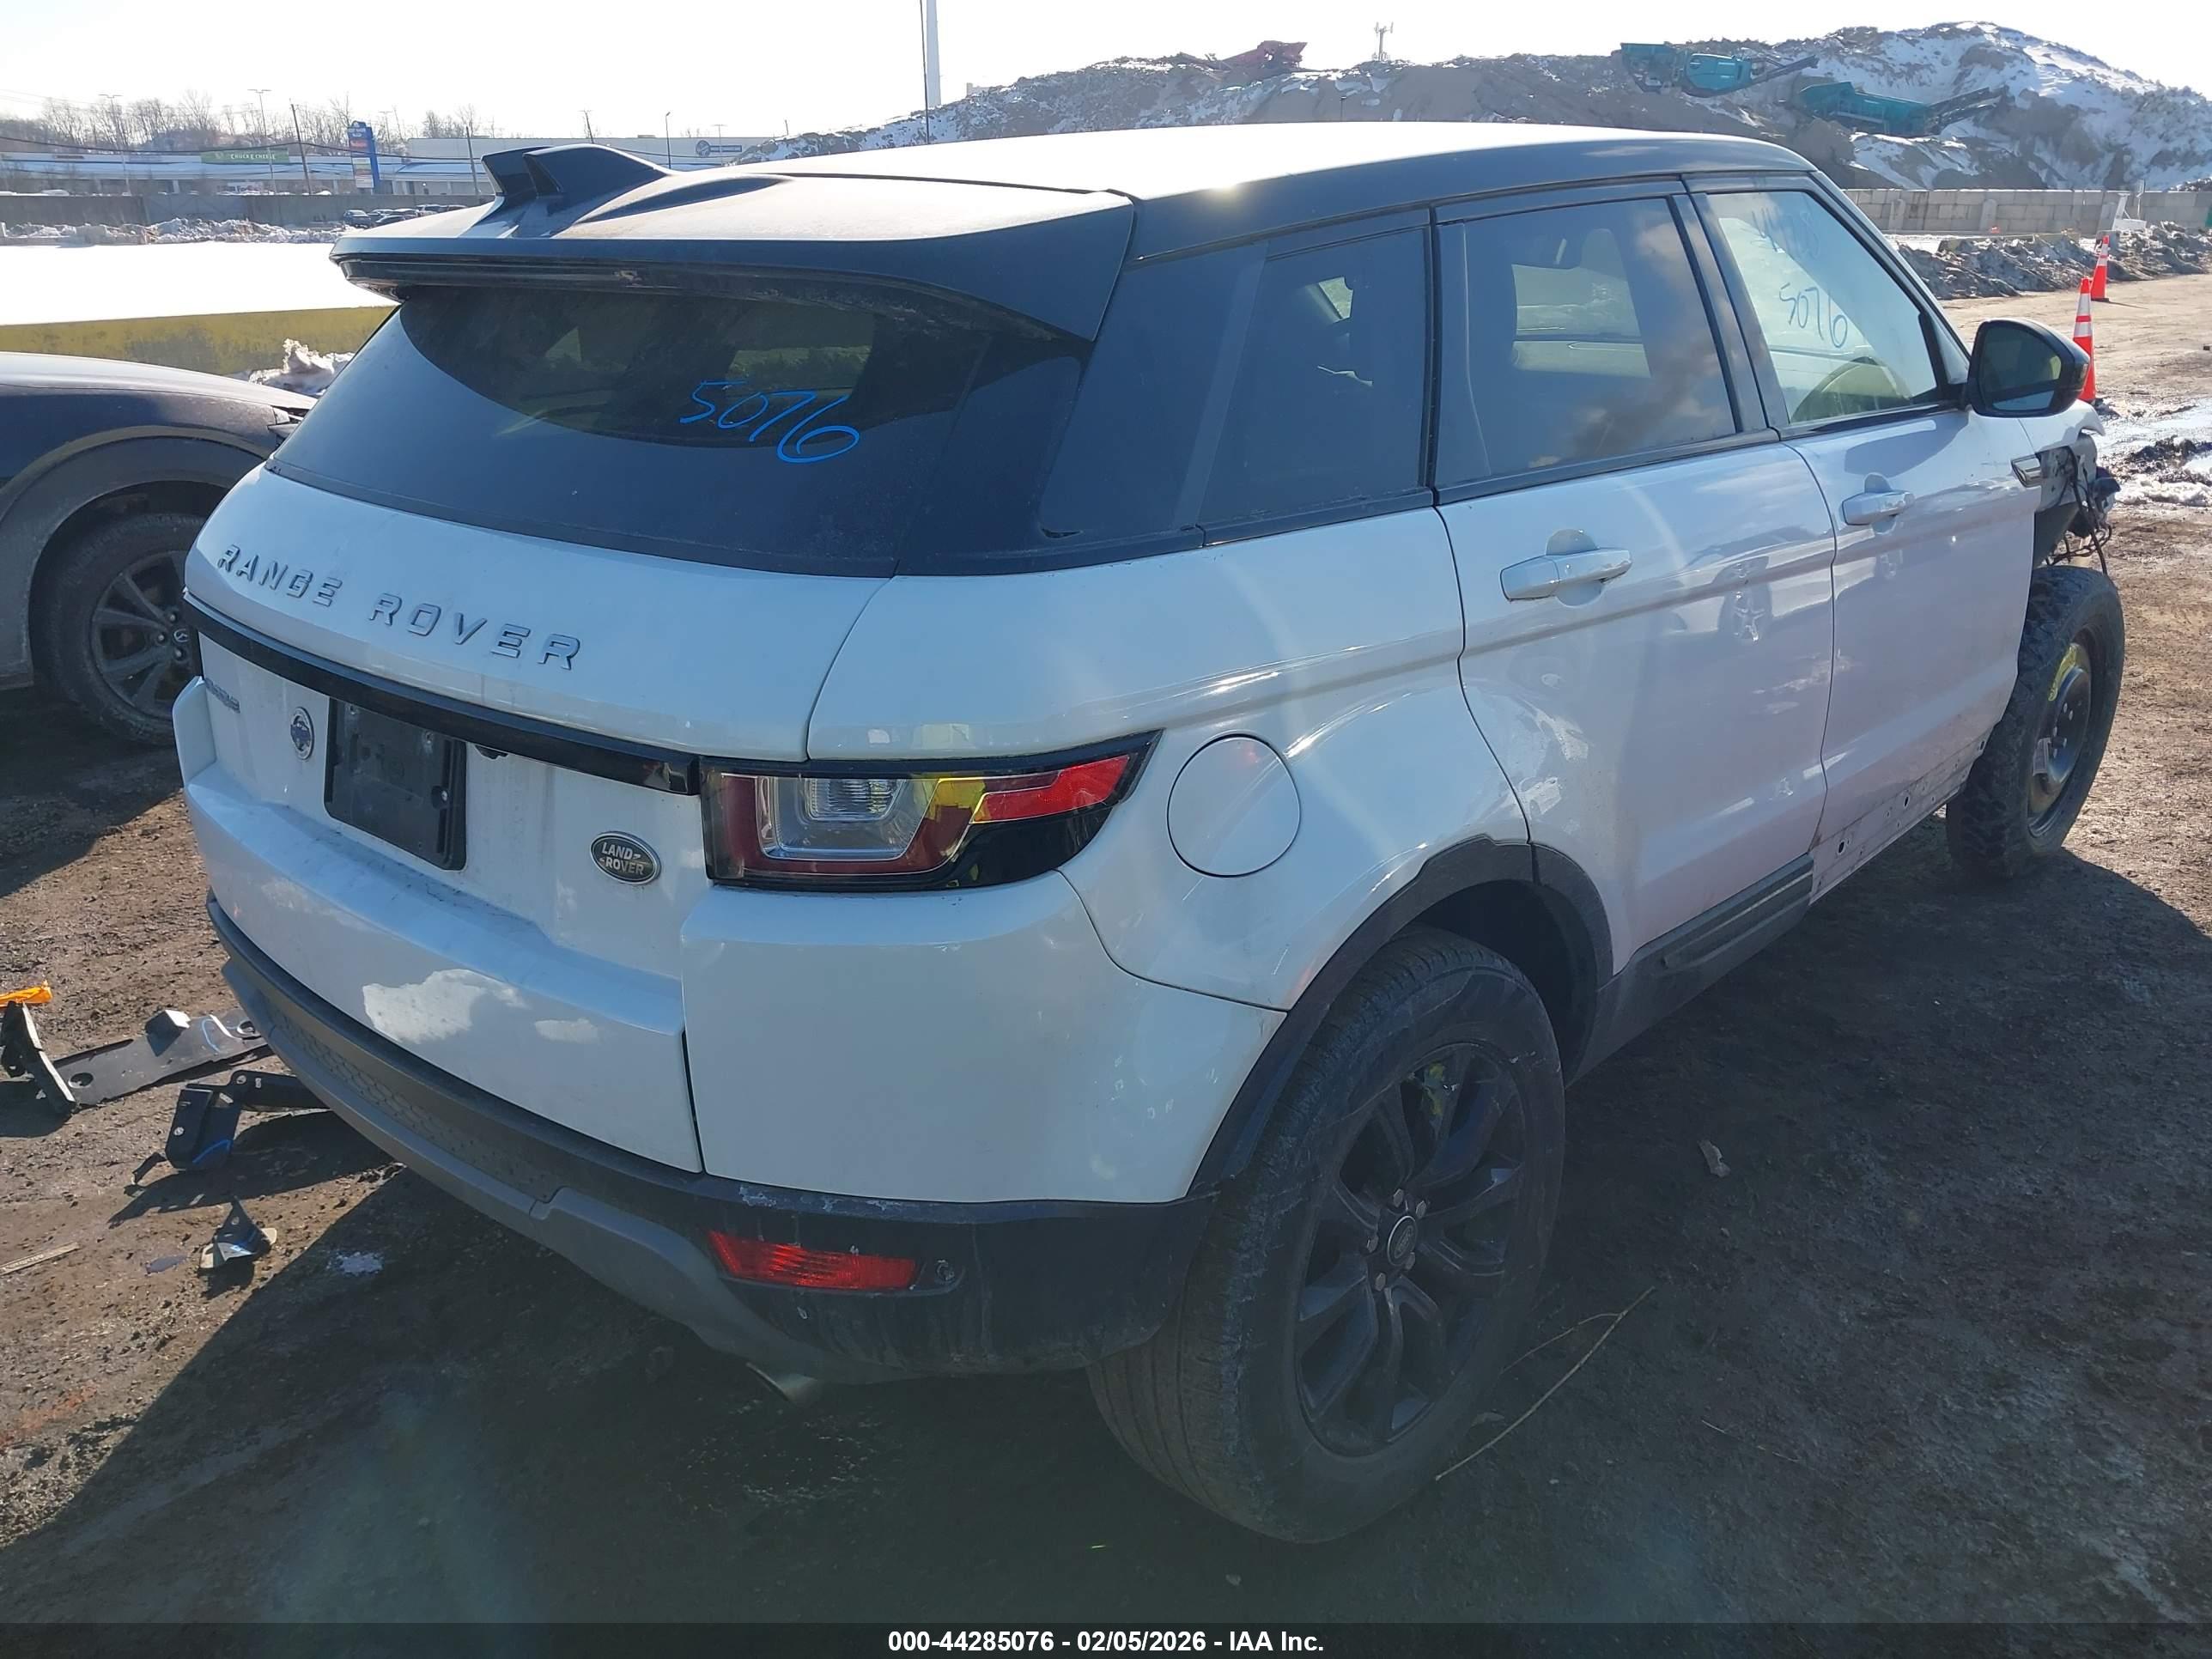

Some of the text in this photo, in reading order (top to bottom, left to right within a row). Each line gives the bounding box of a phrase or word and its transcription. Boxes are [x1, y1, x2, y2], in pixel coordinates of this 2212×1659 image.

[1778, 283, 1848, 349] 5076
[679, 379, 860, 464] 5076
[217, 544, 581, 672] RANGE ROVER
[601, 842, 633, 860] LAND
[605, 856, 644, 875] ROVER
